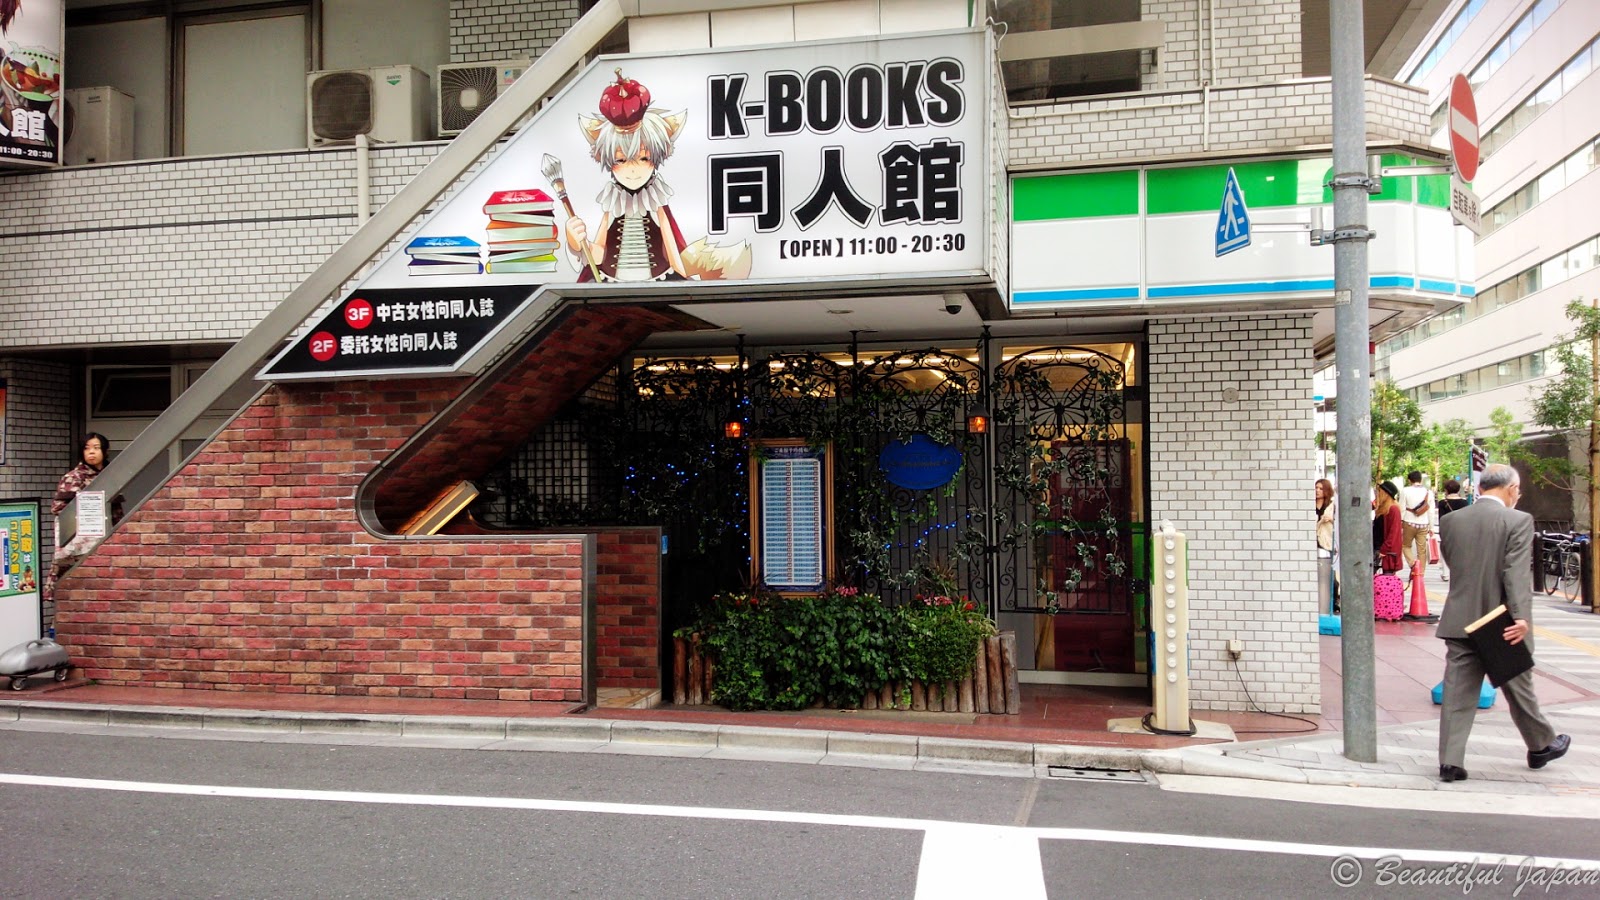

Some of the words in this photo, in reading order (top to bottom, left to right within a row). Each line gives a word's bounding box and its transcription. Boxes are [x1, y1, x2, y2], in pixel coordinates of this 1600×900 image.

[709, 58, 965, 138] K-BOOKS
[709, 138, 964, 234] 同人館
[348, 307, 370, 320] 3F
[376, 298, 495, 322] 中古女性向同人誌
[312, 340, 333, 352] 2F
[340, 332, 458, 355] 委託女性向同人誌
